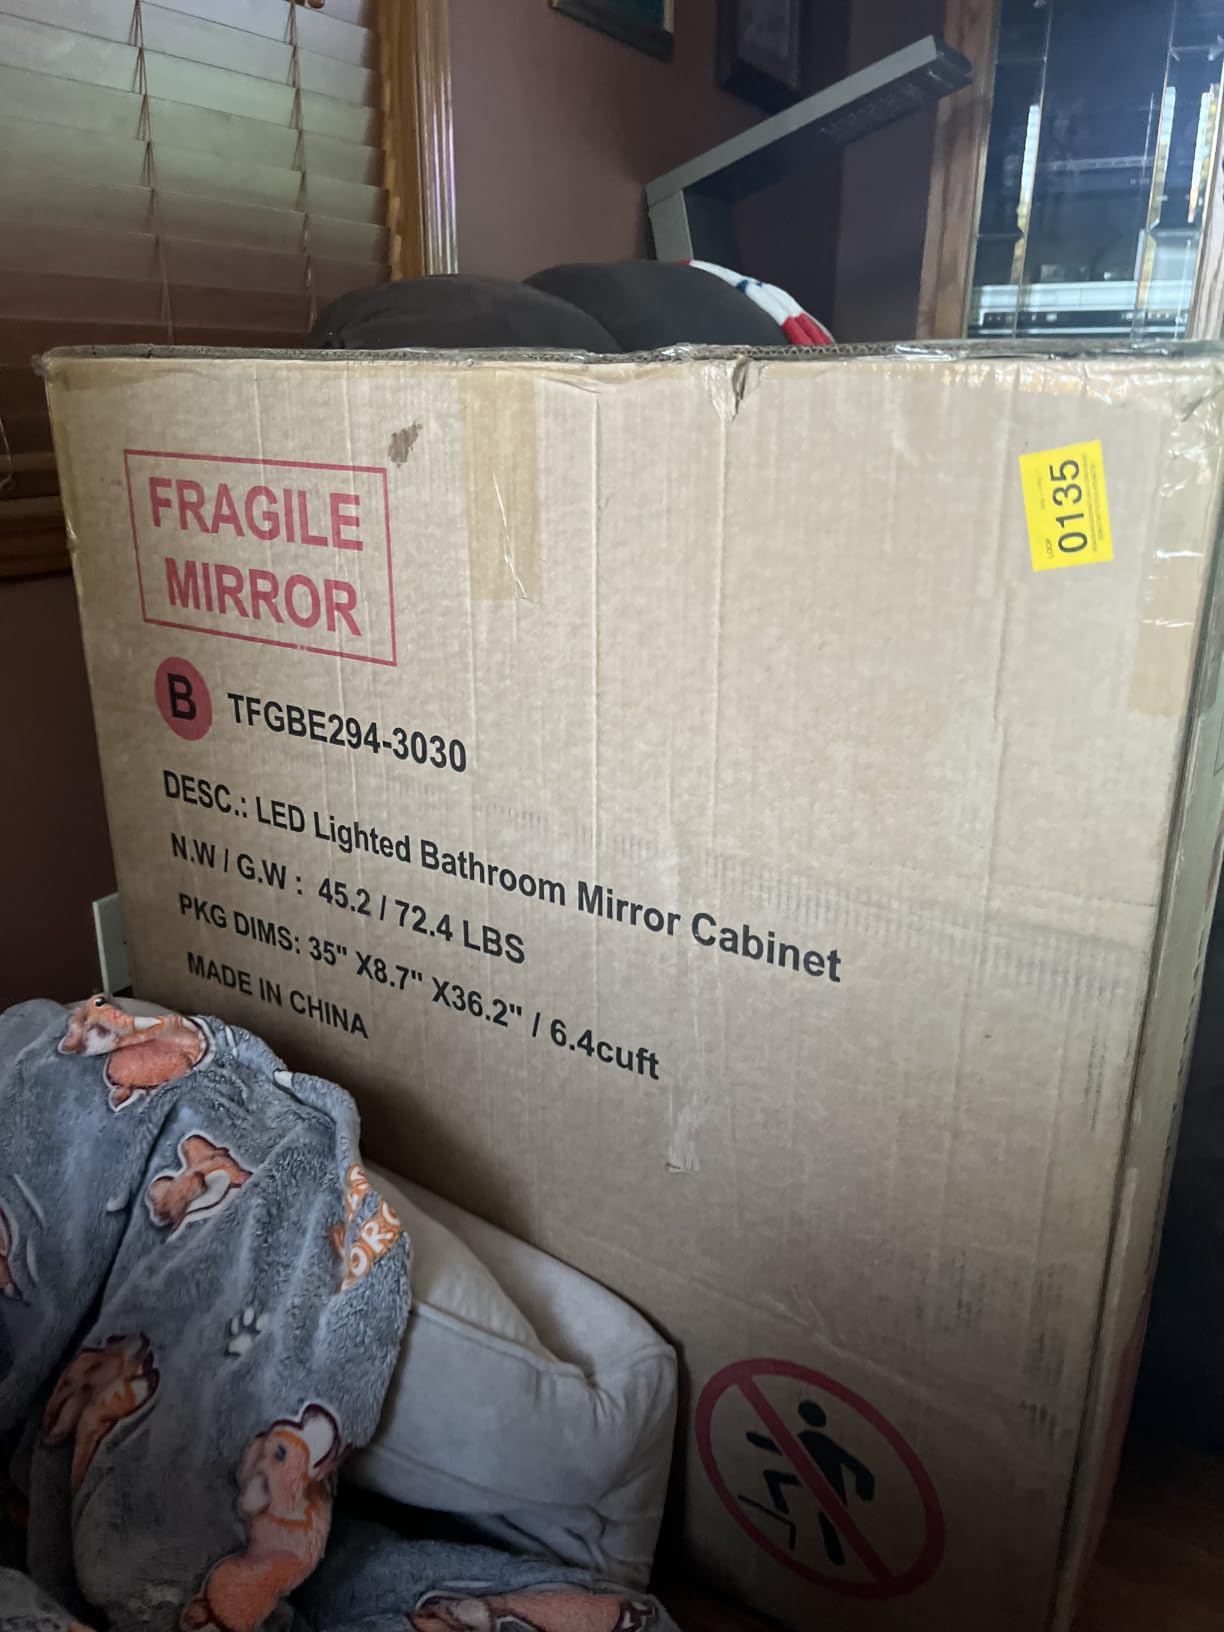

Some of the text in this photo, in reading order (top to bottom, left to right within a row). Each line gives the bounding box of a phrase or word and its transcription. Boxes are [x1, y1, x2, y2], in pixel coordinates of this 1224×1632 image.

[149, 477, 363, 551] FRAGILE
[1048, 459, 1088, 553] 0135
[165, 557, 361, 637] MIRROR
[167, 673, 467, 772] B TFGBE294-3030
[163, 770, 842, 982] DESC.: LED Lighted Bathroom Mirror Cabinet
[318, 878, 372, 917] 45.2
[395, 899, 453, 942] 72.4
[463, 920, 526, 965] LBS
[178, 892, 660, 1081] PKG DIMS: 35" X8.7" X36.2" / 6.4cuft
[187, 951, 369, 1039] MADE IN CHINA
